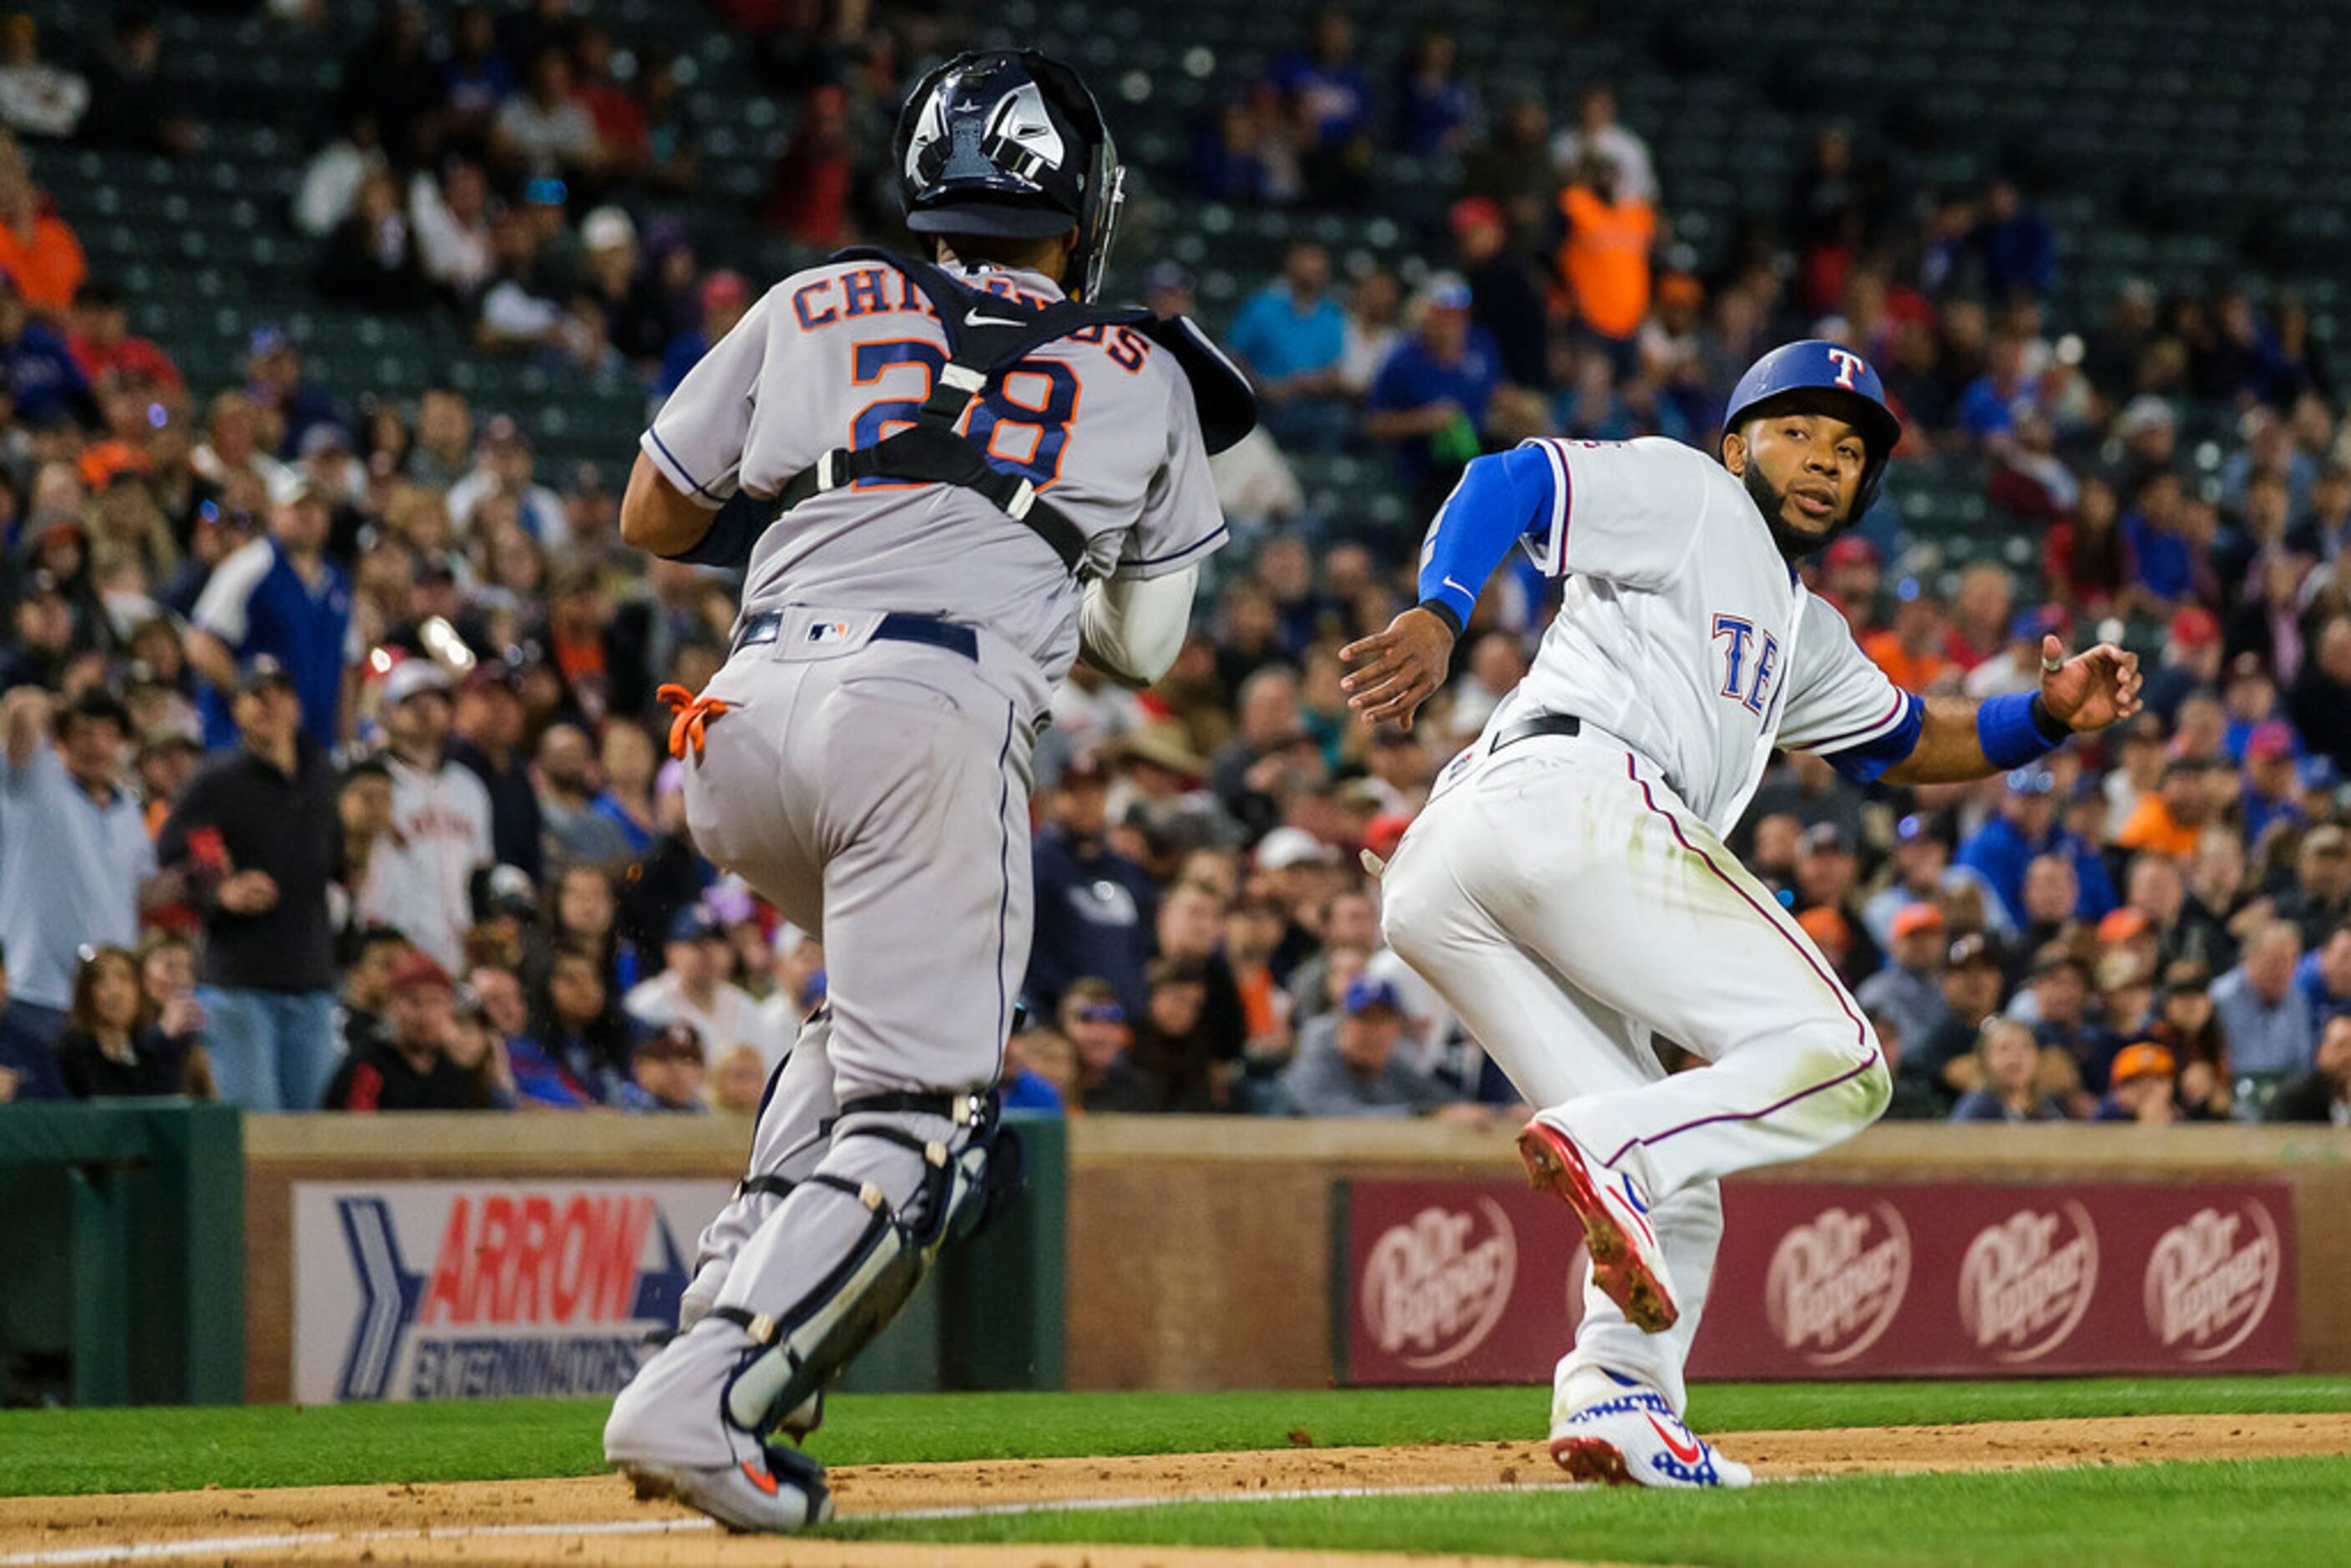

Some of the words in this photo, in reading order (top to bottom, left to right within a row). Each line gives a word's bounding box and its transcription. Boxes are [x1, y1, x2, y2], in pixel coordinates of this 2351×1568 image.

[850, 336, 1083, 493] 28
[1828, 347, 1865, 391] T
[420, 1194, 655, 1327] ARROW
